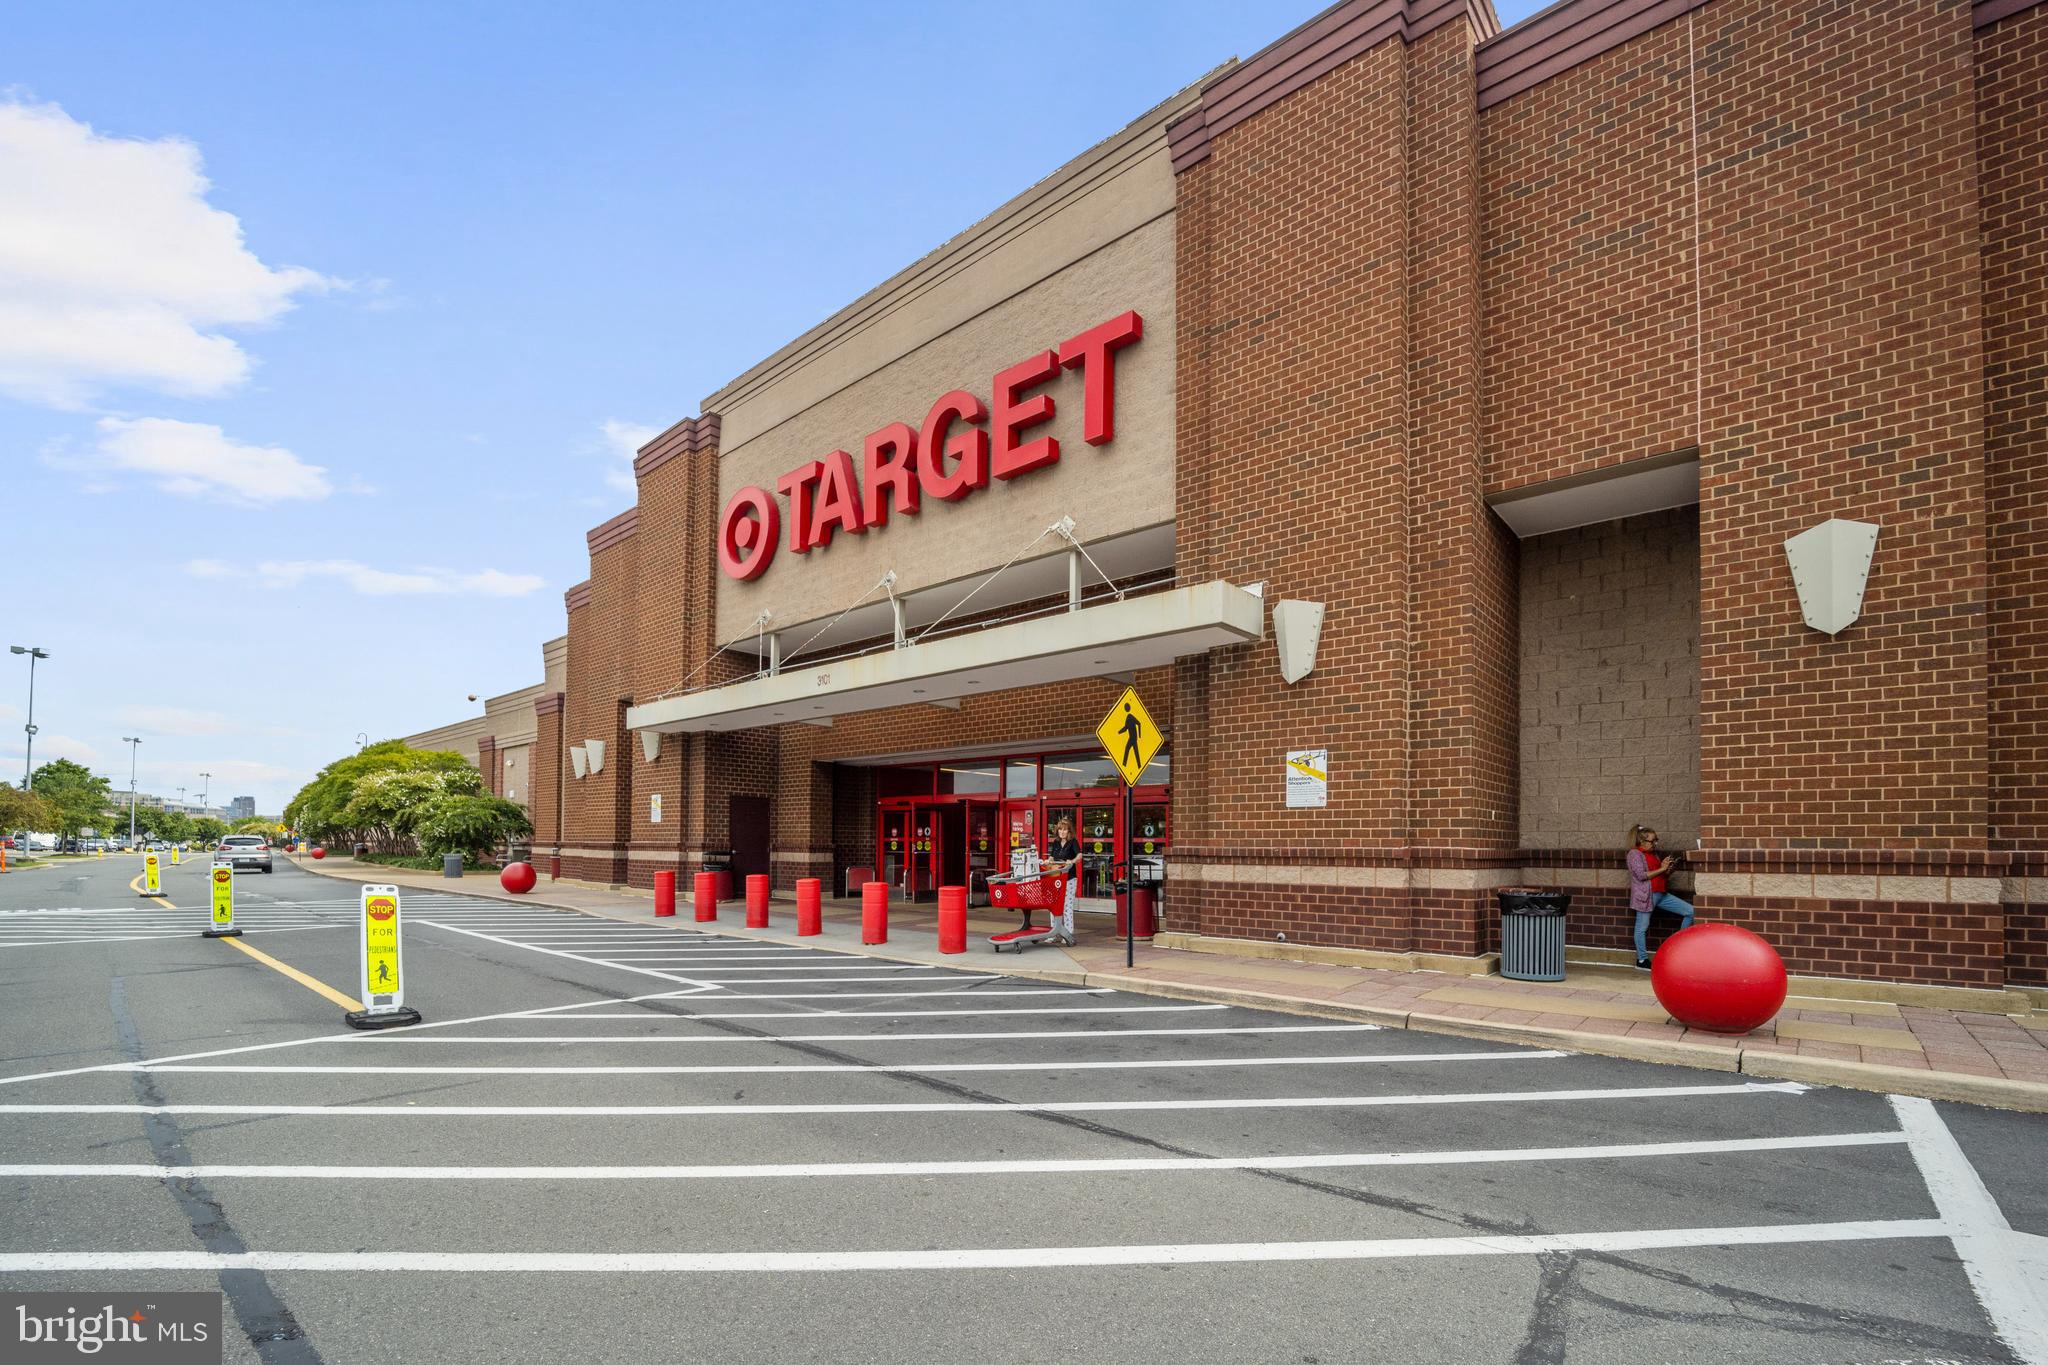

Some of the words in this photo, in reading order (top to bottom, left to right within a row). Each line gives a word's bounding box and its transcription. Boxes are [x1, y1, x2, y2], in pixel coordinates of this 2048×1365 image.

[778, 310, 1142, 554] TARGET
[369, 905, 394, 914] STOP
[372, 928, 393, 936] FOR
[368, 946, 396, 954] PEDESTRIANS
